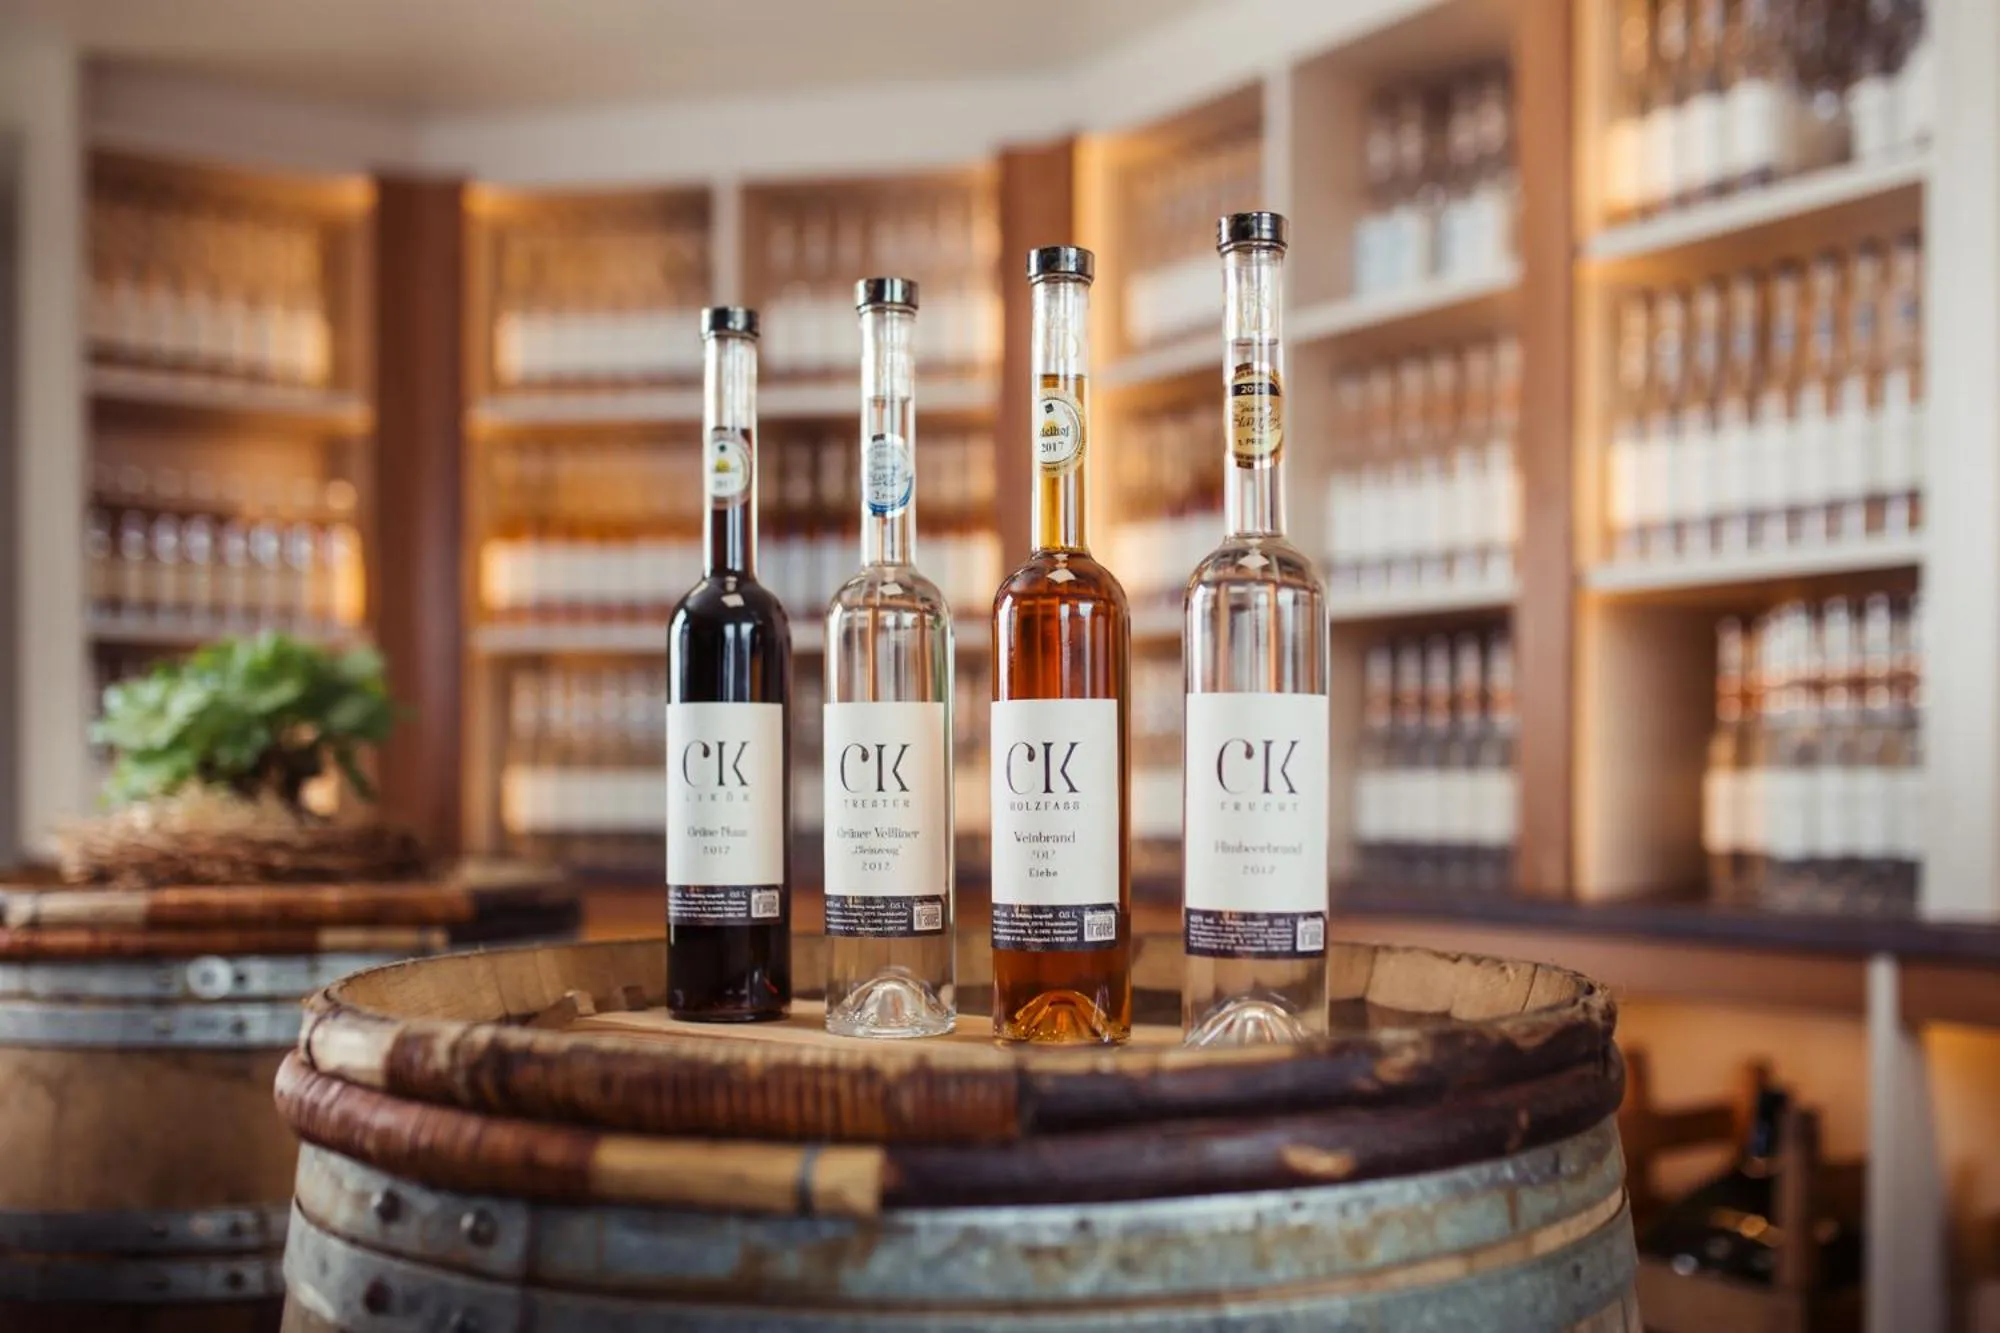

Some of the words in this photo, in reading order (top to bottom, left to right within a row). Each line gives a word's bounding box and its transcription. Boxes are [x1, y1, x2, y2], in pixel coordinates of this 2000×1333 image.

[1041, 441, 1064, 453] 2017
[682, 740, 750, 788] CK
[840, 743, 911, 793] CK
[1006, 741, 1082, 795] CK
[1216, 737, 1299, 795] CK
